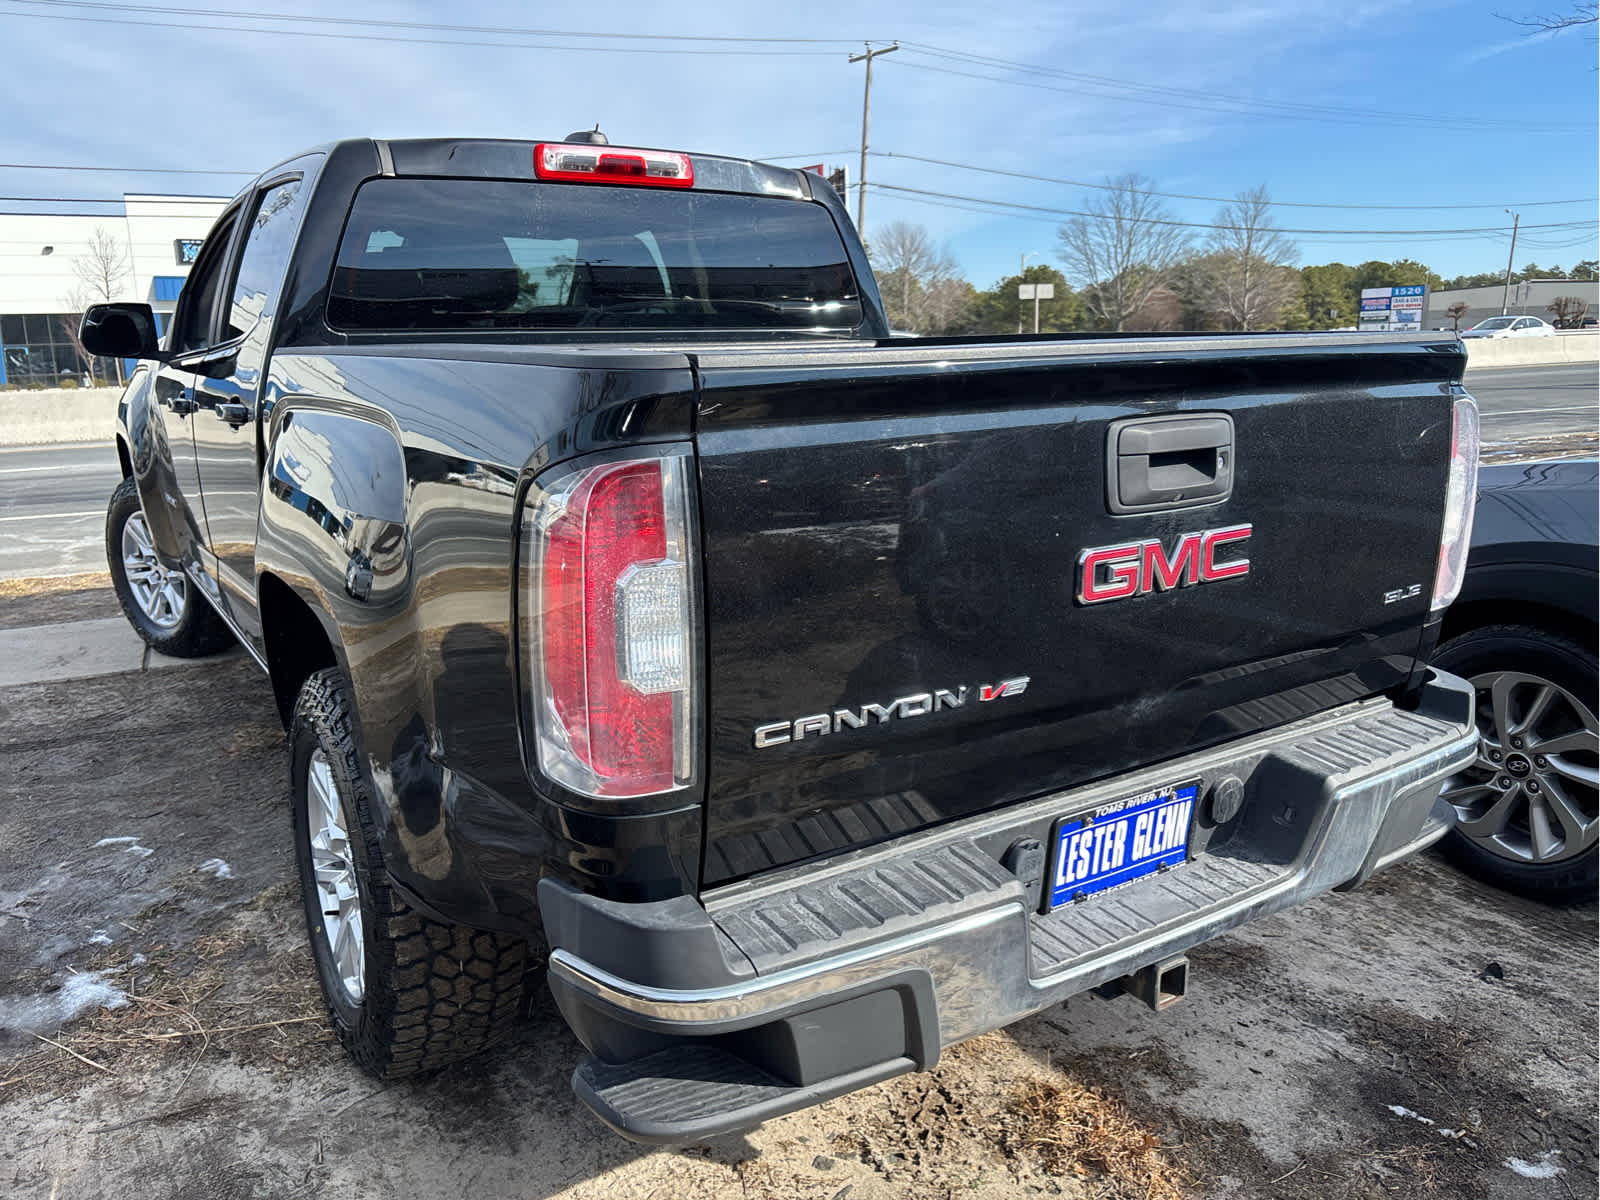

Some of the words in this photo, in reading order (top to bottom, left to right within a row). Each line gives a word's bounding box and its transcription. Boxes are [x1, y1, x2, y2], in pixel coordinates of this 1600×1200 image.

[1394, 287, 1421, 296] 1520
[1077, 523, 1252, 605] GMC
[754, 686, 967, 748] CANYON
[1095, 802, 1125, 818] TOMS
[1159, 786, 1173, 799] NJ
[1055, 819, 1129, 887] LESTER
[1131, 800, 1192, 862] GLENN
